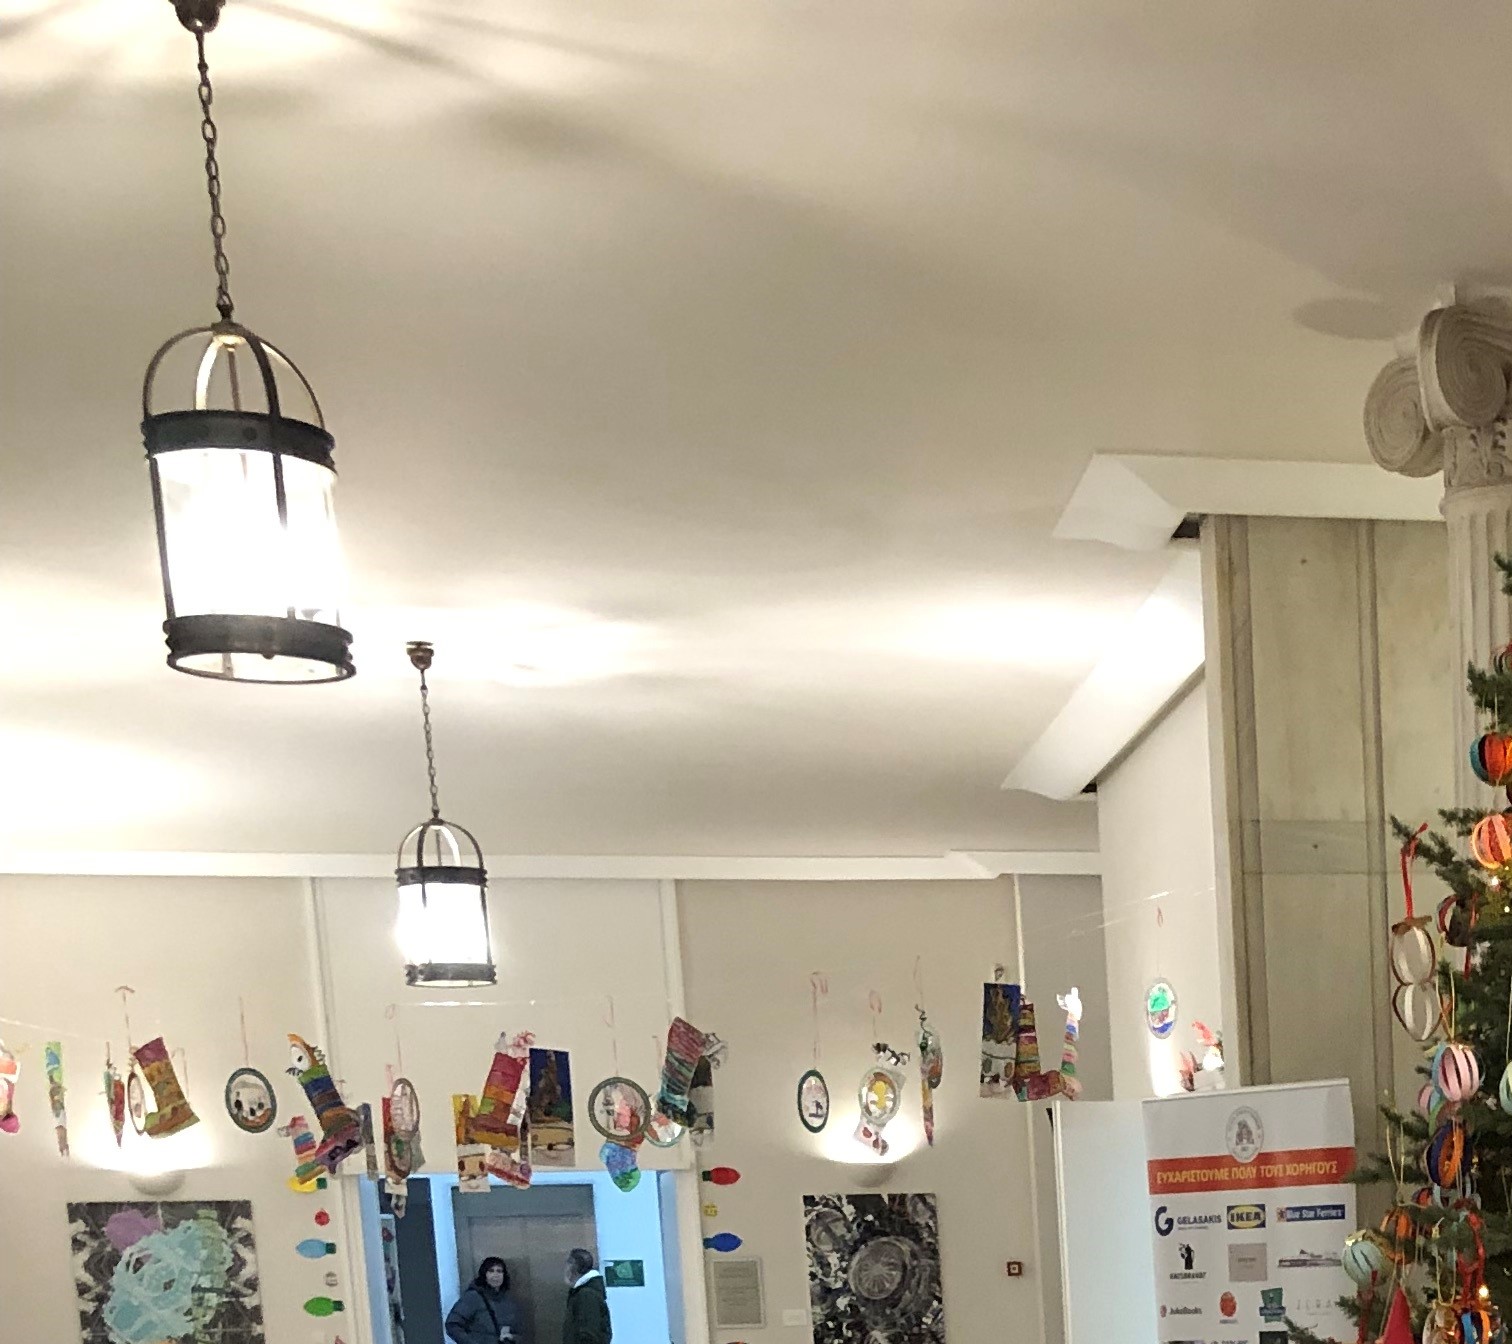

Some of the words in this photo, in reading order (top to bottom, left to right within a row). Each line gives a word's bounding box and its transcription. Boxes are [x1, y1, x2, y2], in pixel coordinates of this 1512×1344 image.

[1157, 1168, 1229, 1184] ΕΥΧΑΡΙΣΤΟΥΜΕ
[1231, 1165, 1256, 1180] ΠΟΛΥ
[1260, 1164, 1284, 1178] ΤΟΥΣ
[1286, 1161, 1338, 1177] ΧΟΡΗΓΟΥΣ
[1177, 1214, 1222, 1225] GELASAKIS
[1230, 1210, 1262, 1222] IKEA
